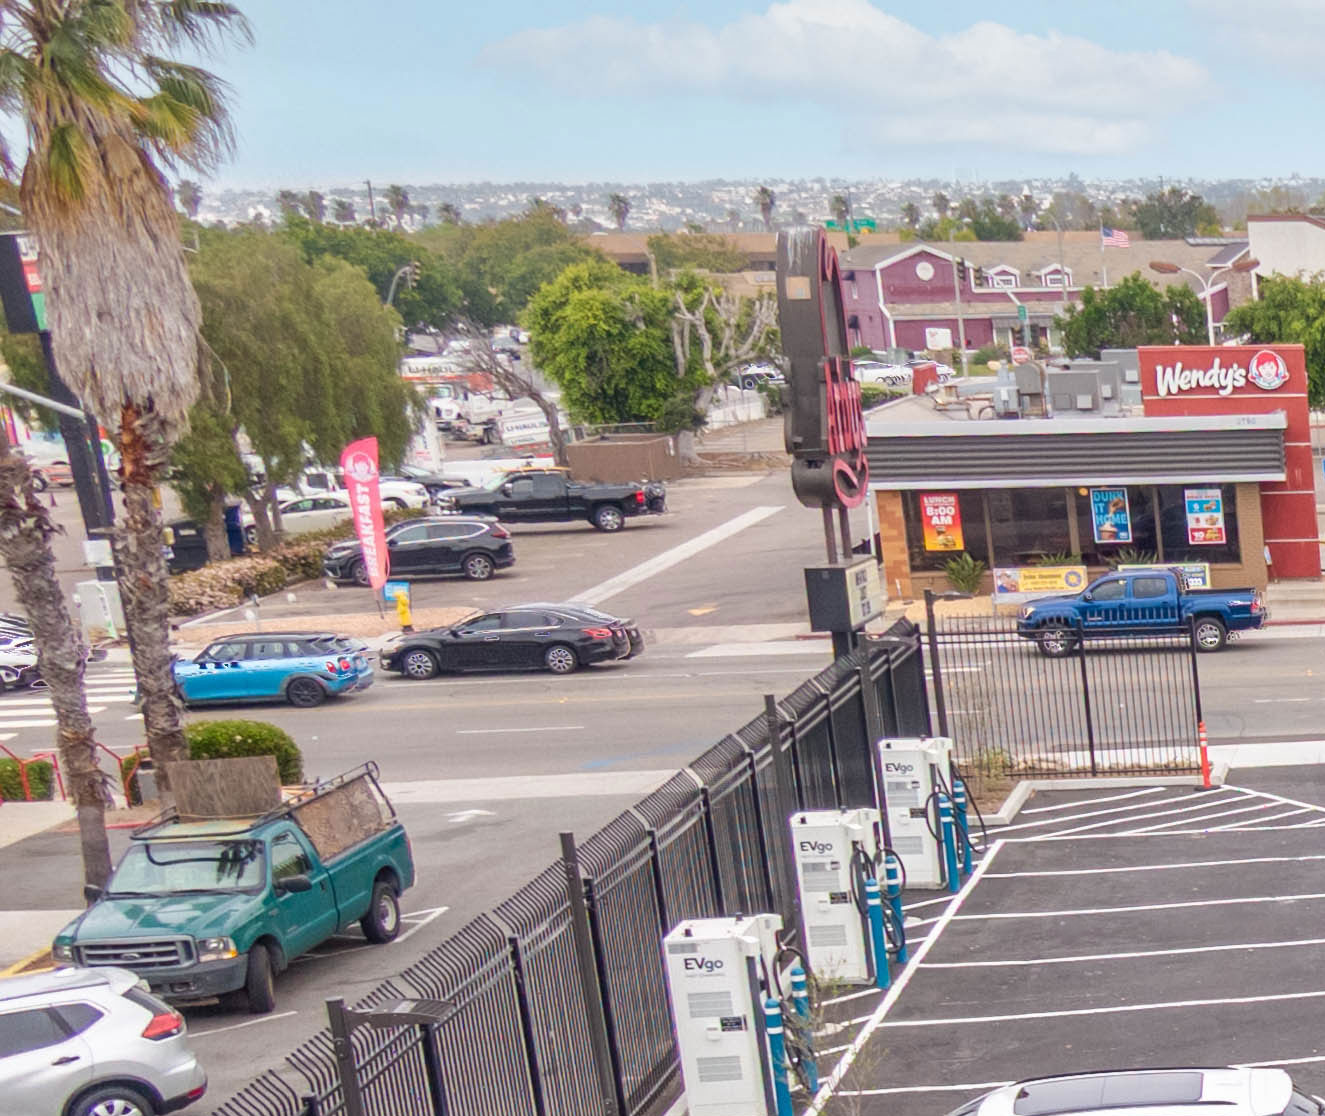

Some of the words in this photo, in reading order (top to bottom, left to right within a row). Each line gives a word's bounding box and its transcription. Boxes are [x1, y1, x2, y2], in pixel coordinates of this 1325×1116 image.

[1156, 357, 1246, 397] Wendy's
[926, 506, 955, 516] 8:00
[1095, 503, 1105, 514] IT
[931, 516, 953, 526] AM
[1096, 514, 1128, 525] HOME
[356, 483, 379, 577] BREAKFAST
[885, 762, 914, 774] EVgo
[800, 840, 833, 854] EVgo
[684, 957, 724, 972] EVgo
